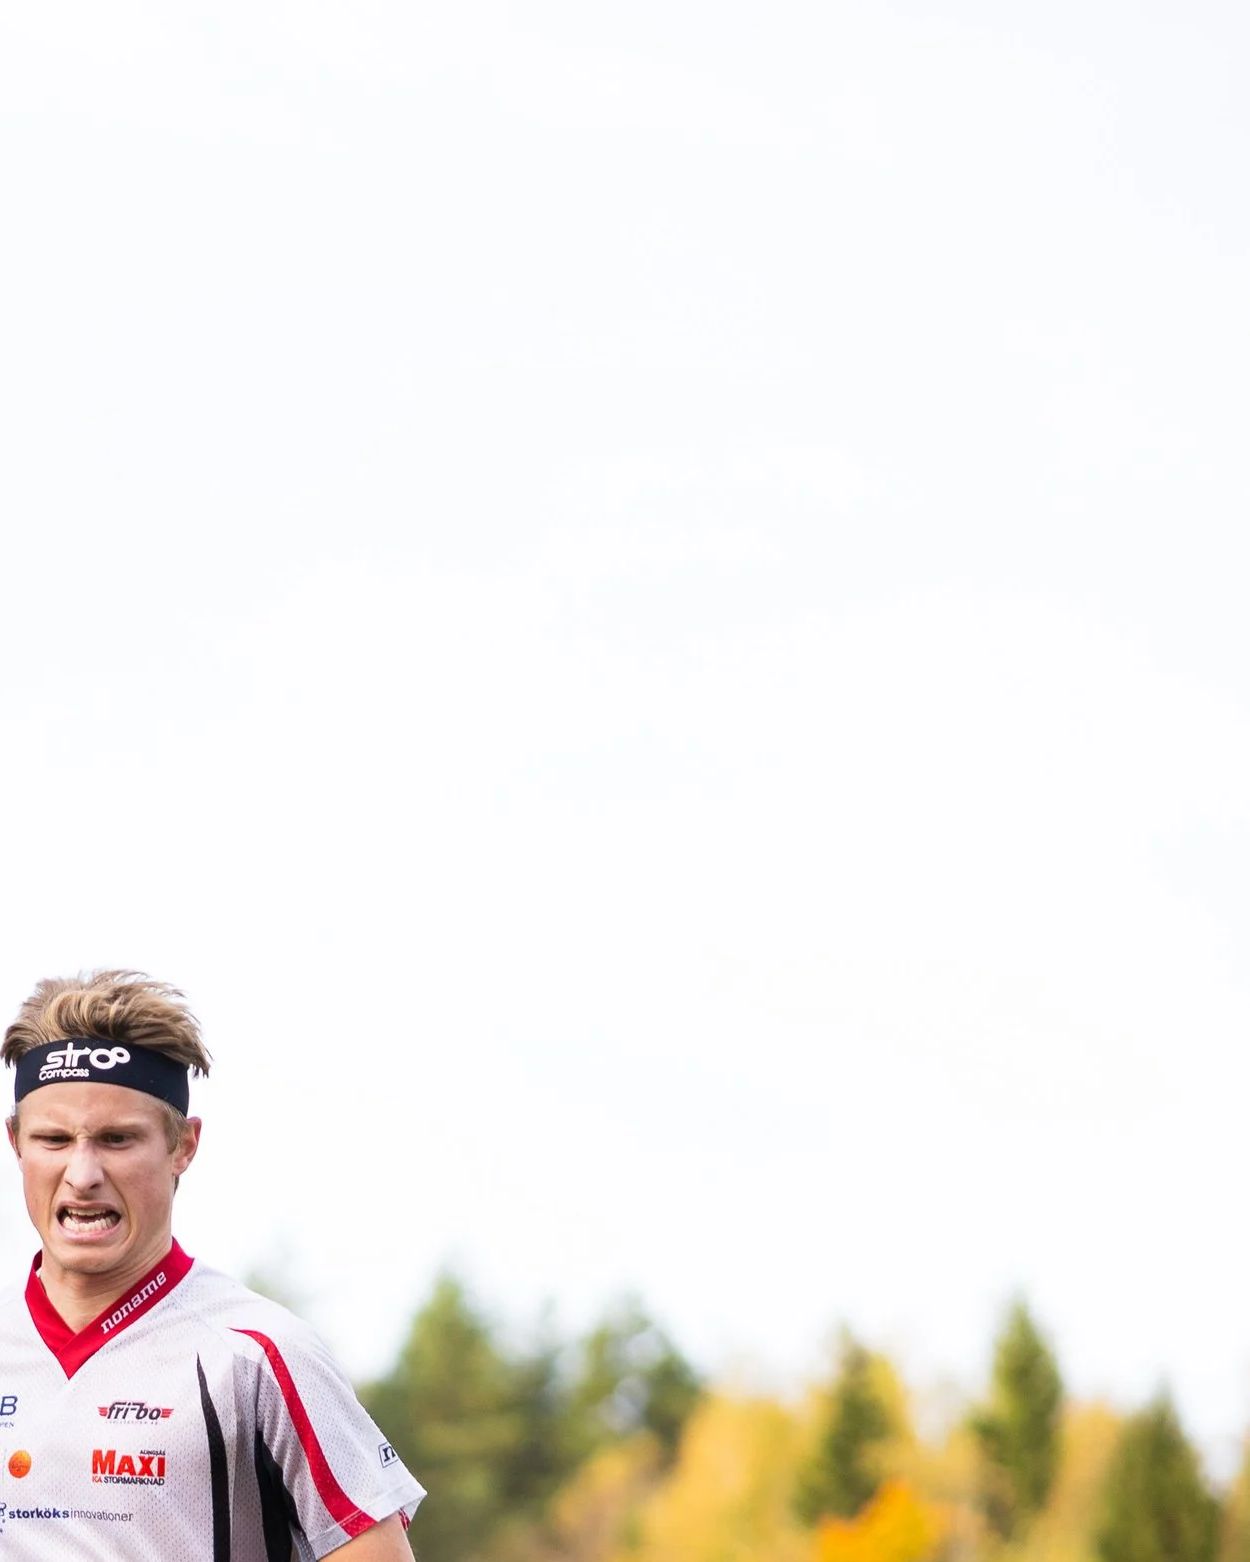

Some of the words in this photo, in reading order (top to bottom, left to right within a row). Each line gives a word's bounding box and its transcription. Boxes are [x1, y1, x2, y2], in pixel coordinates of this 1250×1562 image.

[100, 1271, 167, 1335] noname
[92, 1448, 166, 1477] MAXI
[103, 1475, 166, 1487] STORMARKNAD
